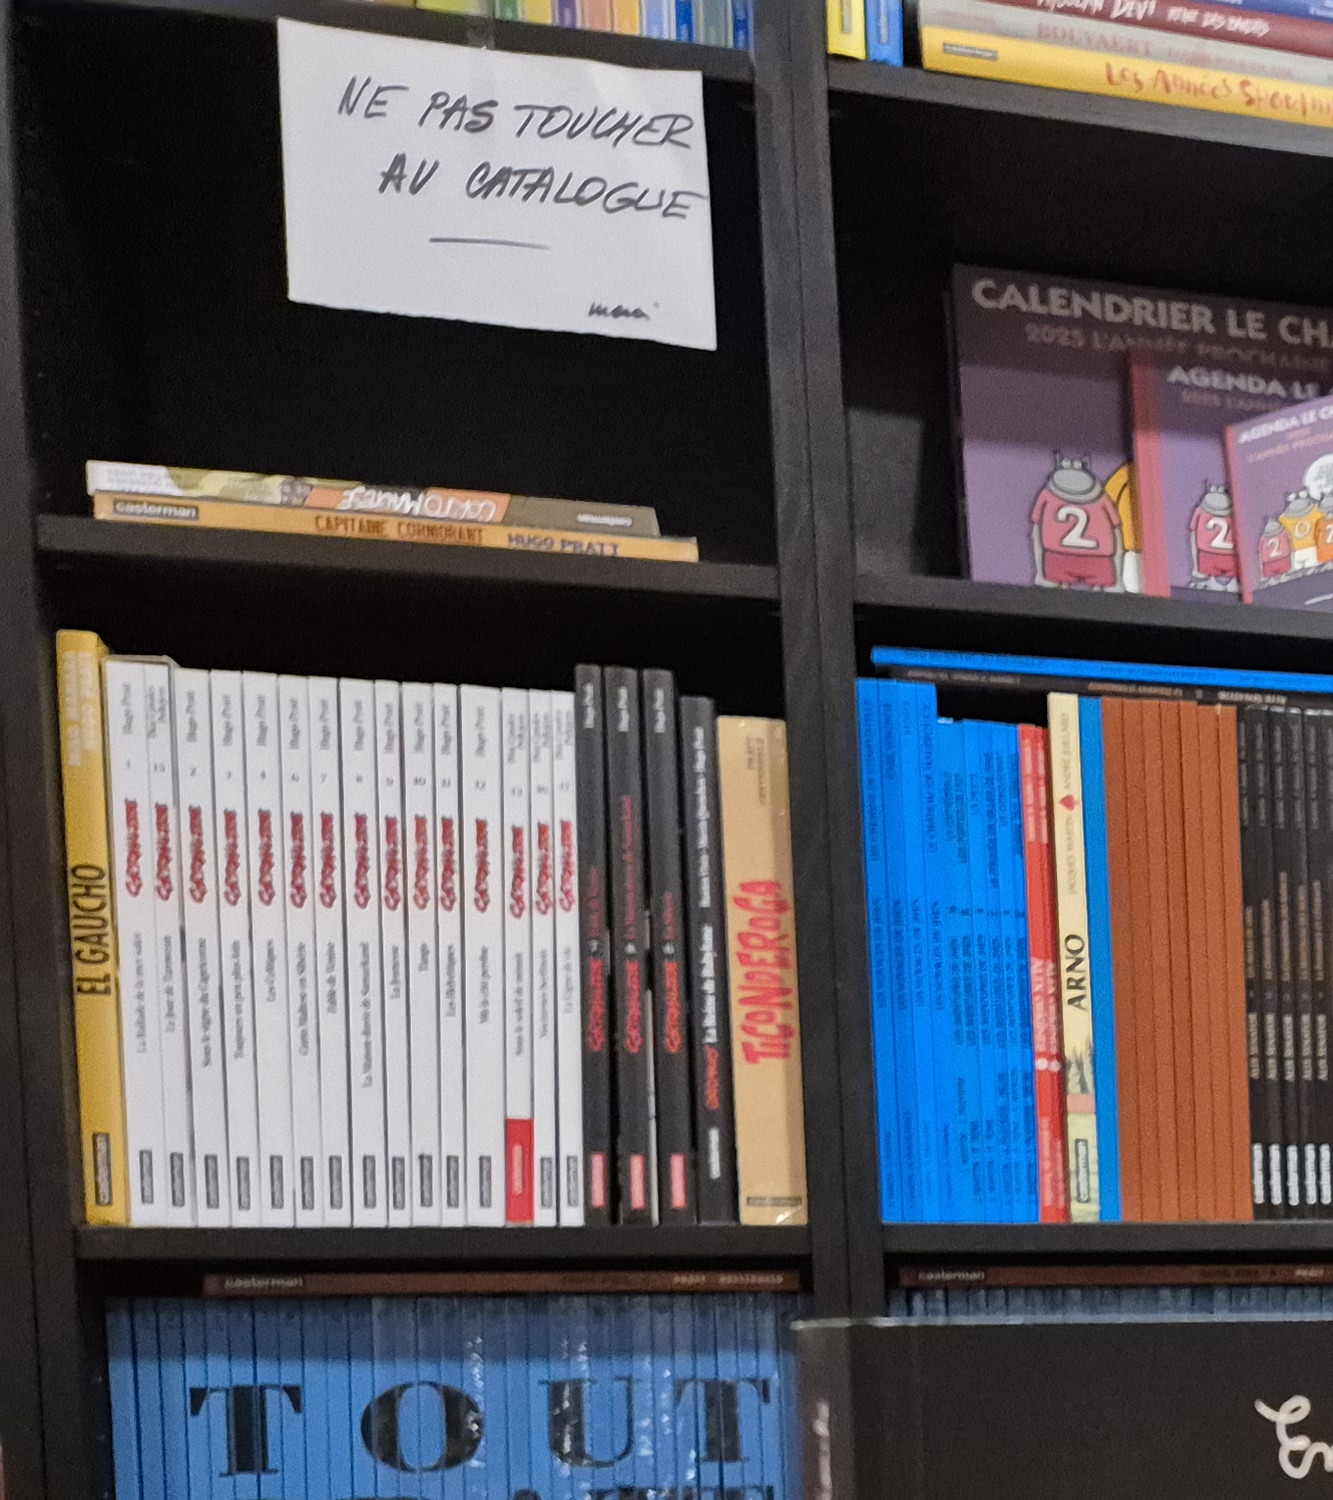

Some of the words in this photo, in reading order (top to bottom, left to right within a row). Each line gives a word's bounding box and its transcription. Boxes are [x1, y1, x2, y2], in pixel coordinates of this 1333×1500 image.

[339, 76, 409, 119] NE
[419, 91, 499, 134] PAS
[514, 104, 695, 150] TOUCHER
[379, 153, 440, 195] AU
[466, 161, 709, 220] CATALOGUE
[971, 278, 1216, 335] CALENDRIER
[1226, 308, 1268, 341] LE
[1167, 365, 1287, 398] AGENDA
[1238, 416, 1299, 444] AGENDA
[1056, 506, 1099, 550] 2
[1205, 517, 1234, 550] 2
[70, 863, 110, 967] GAUCHO
[76, 975, 113, 998] EL
[1063, 933, 1090, 1012] ARNO
[189, 1374, 773, 1477] TOUT
